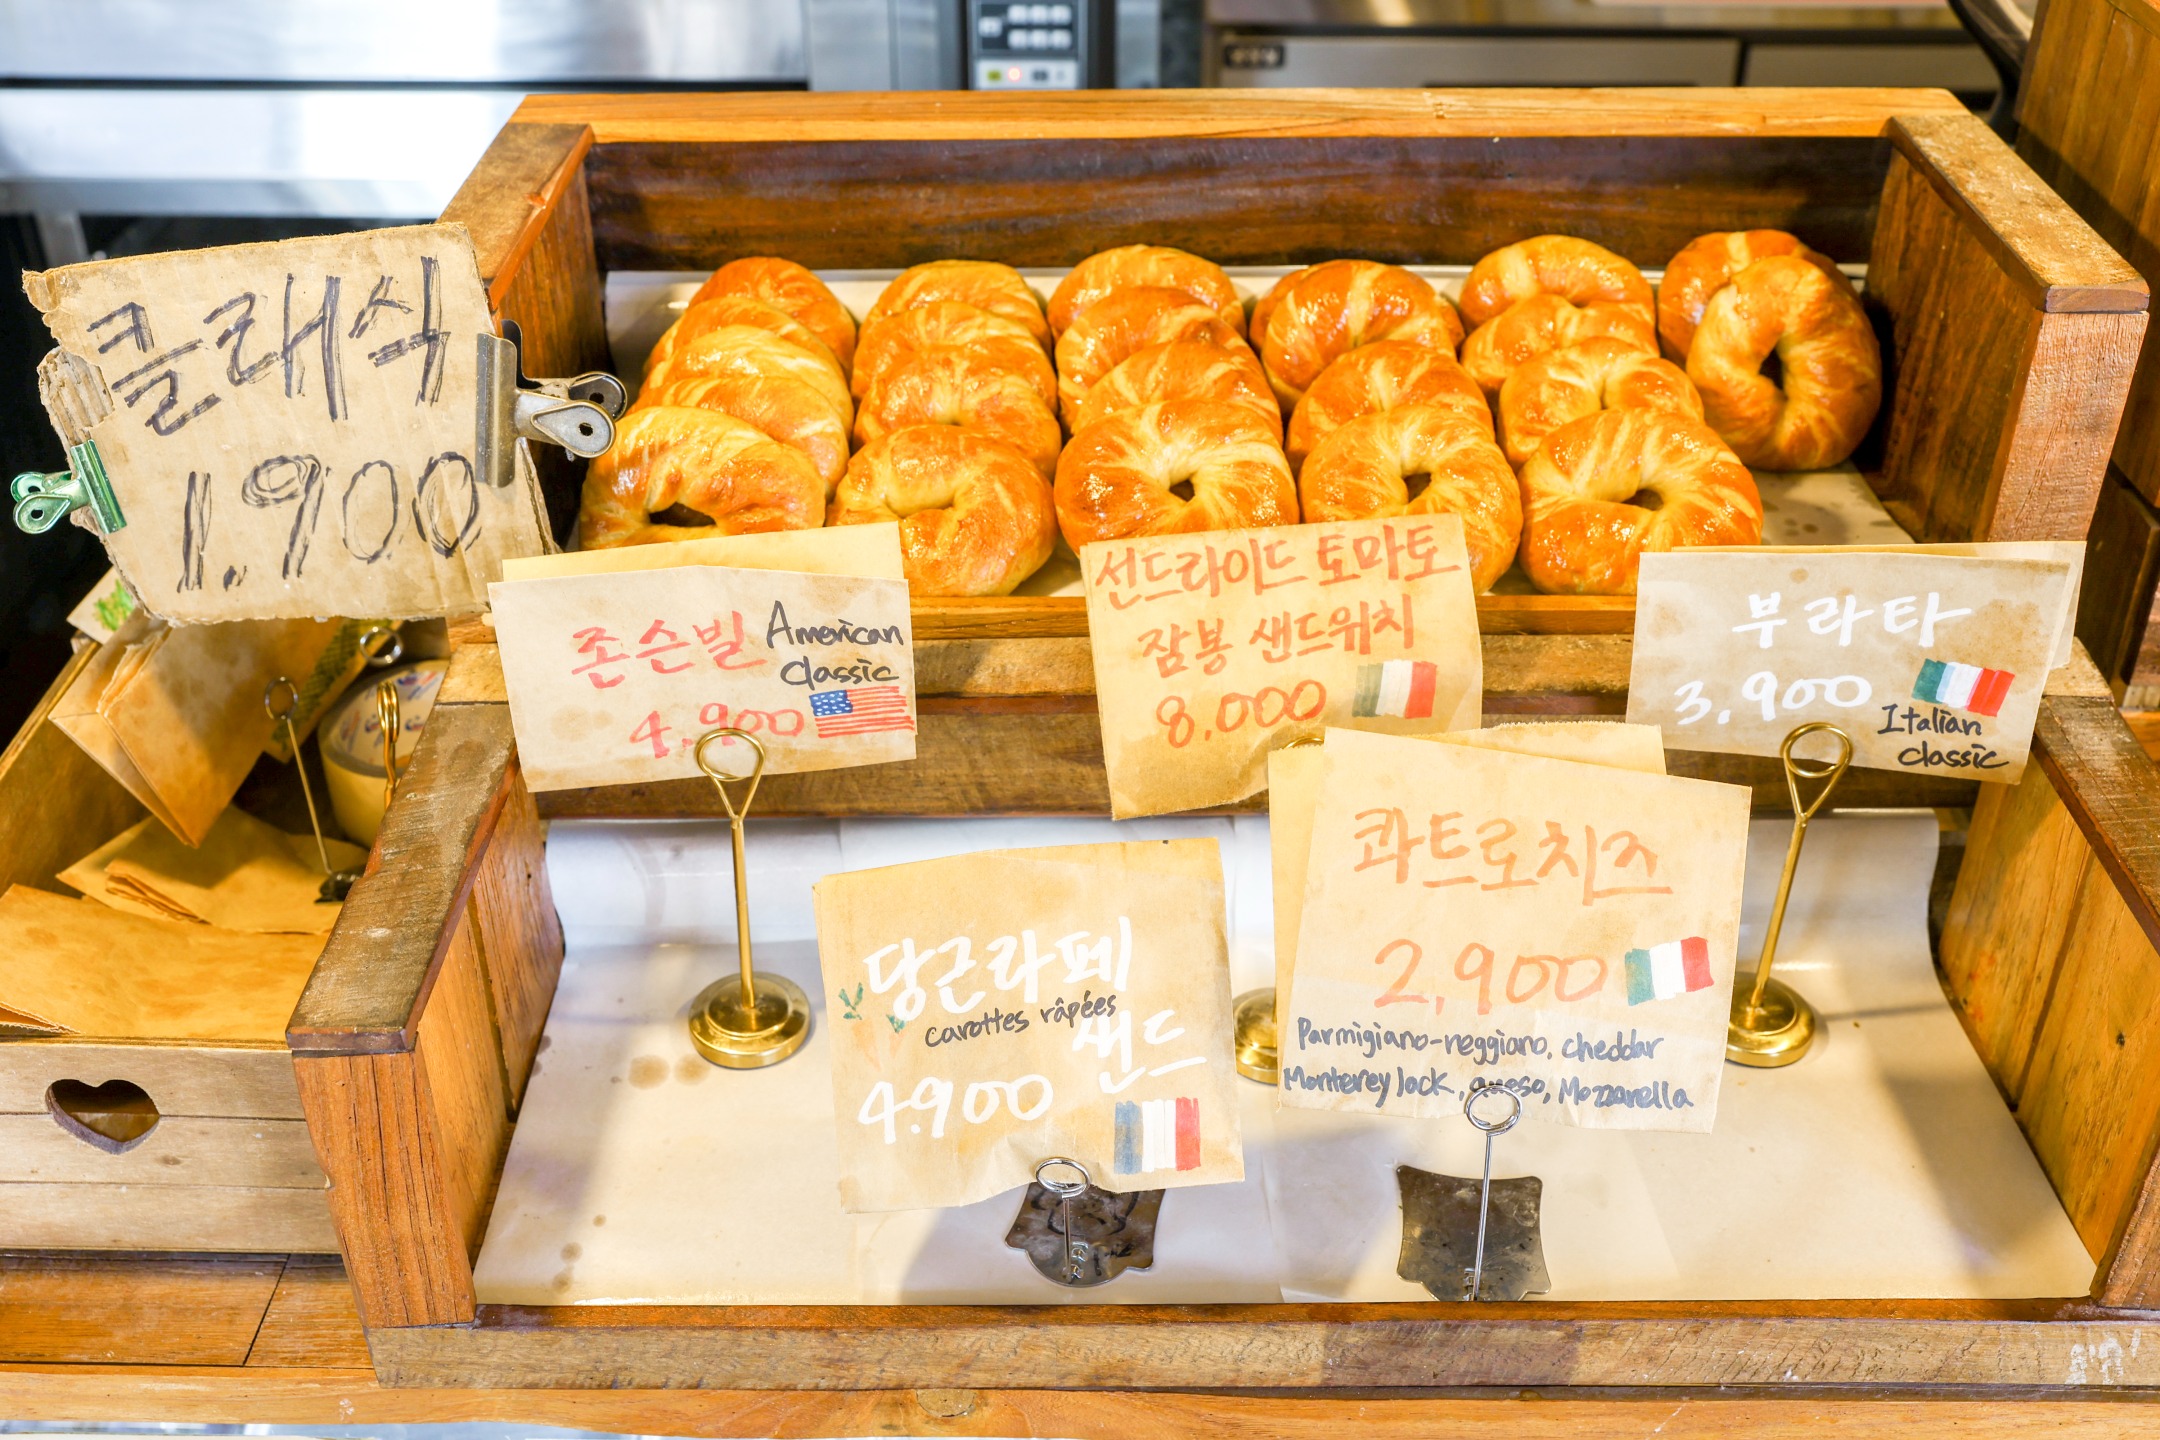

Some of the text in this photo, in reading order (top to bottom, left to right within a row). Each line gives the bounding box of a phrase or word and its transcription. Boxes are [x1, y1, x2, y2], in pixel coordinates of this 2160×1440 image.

[87, 255, 450, 436] 클래식
[1095, 524, 1462, 611] 선드라이드 토마토
[571, 611, 768, 689] 존슨빌
[766, 600, 904, 649] American
[1138, 594, 1414, 678] 잠봉 샌드위치
[1732, 592, 1971, 649] 부라타
[1877, 704, 1982, 736] Italian
[1354, 807, 1673, 906] 콰트로치즈
[863, 916, 1132, 1021] 당근라페
[1374, 938, 1609, 1015] 2,900
[925, 990, 1117, 1048] carottes râpées
[1071, 1009, 1208, 1094] 샌드
[1561, 1028, 1665, 1063] cheddar
[1283, 1065, 1391, 1108] Monterey
[1558, 1076, 1695, 1110] Mozzarella
